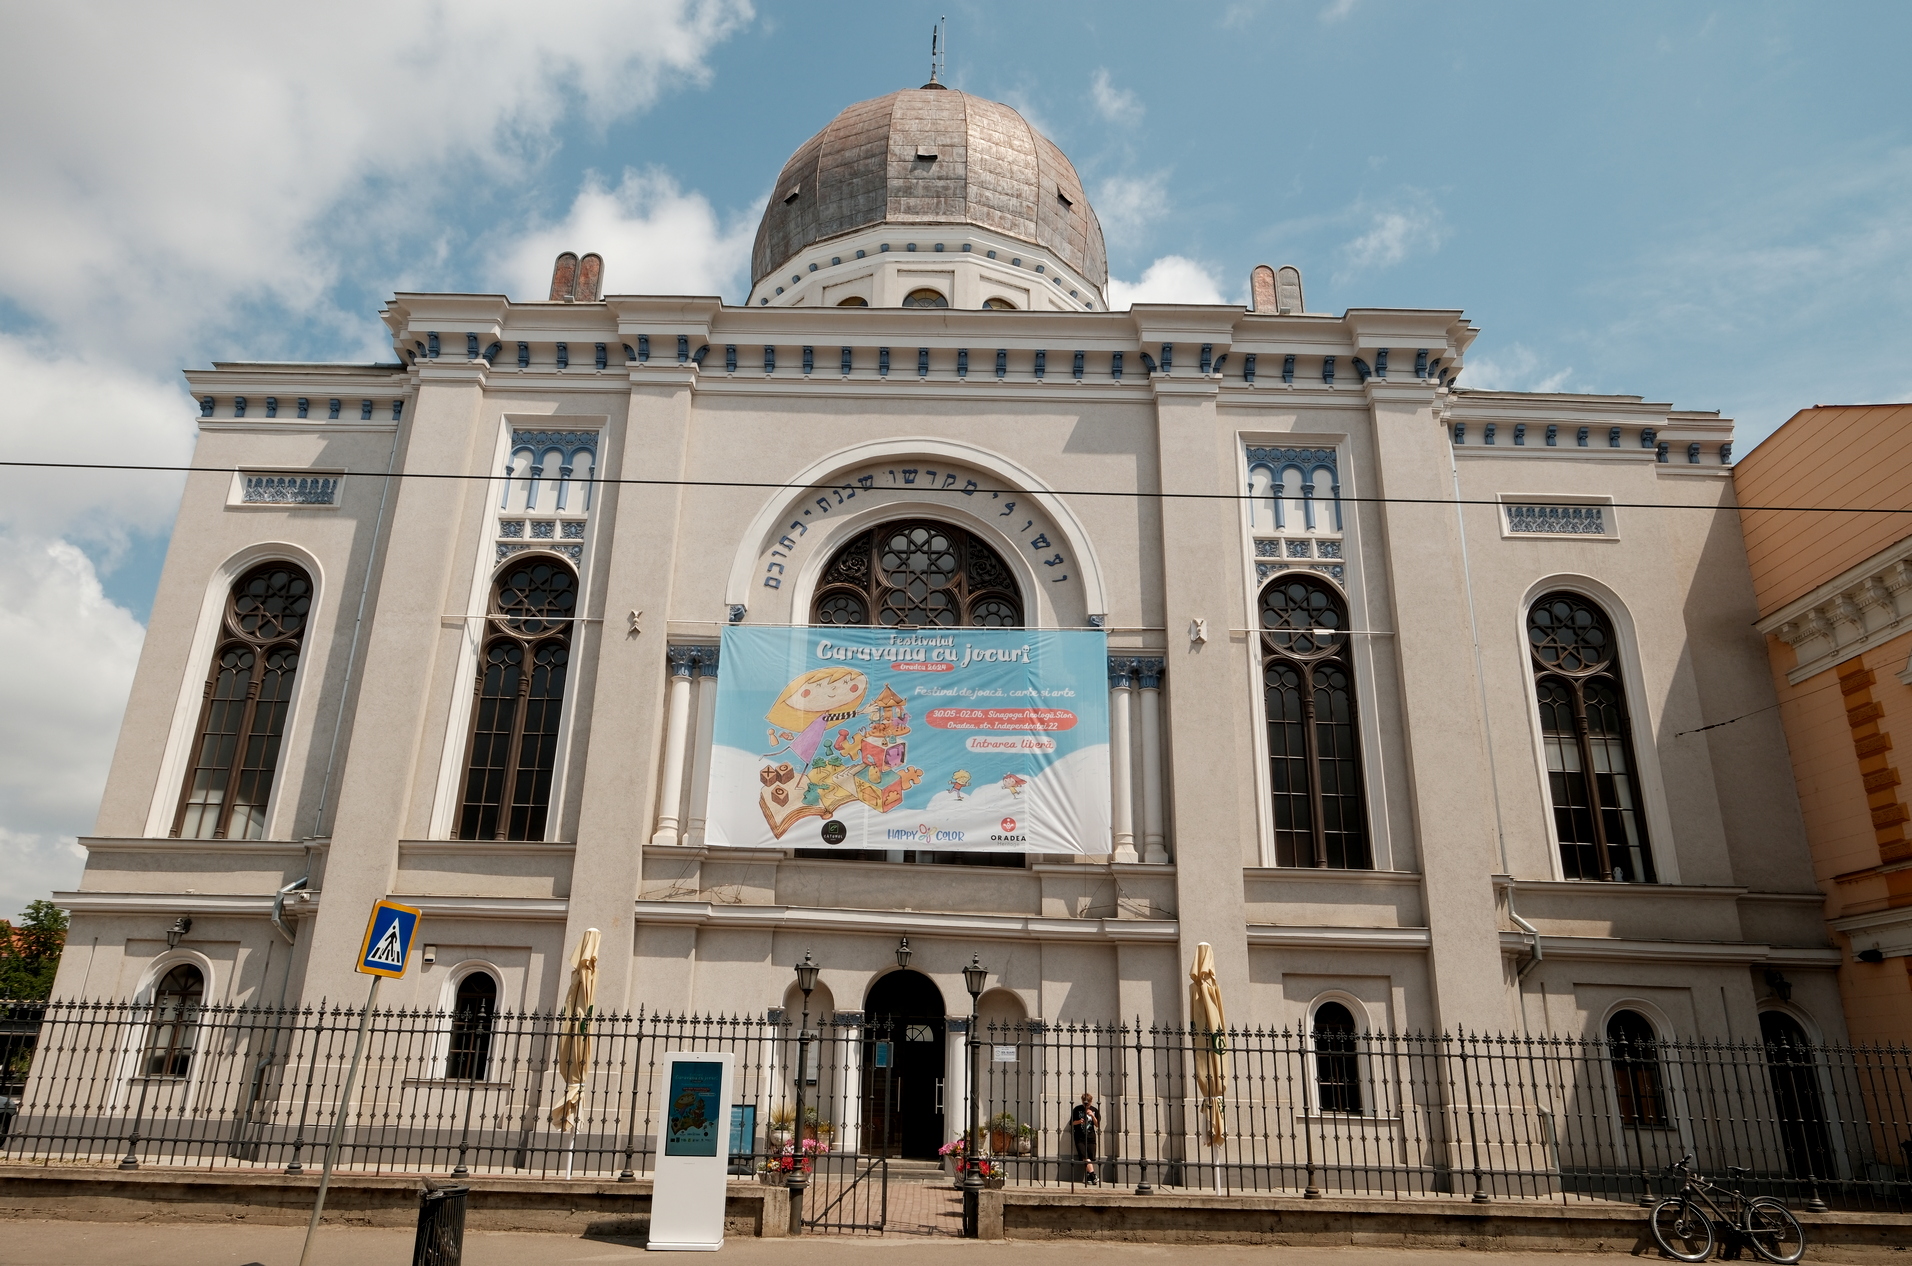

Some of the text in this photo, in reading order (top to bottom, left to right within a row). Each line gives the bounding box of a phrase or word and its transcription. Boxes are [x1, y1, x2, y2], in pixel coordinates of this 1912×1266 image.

[890, 635, 955, 647] Festivalul
[816, 640, 1031, 668] Caravana cu jocuri
[900, 663, 947, 671] Oradea 2024
[914, 686, 958, 697] Festival
[959, 687, 972, 696] de
[970, 687, 1007, 699] joacă,
[1009, 688, 1038, 697] carte
[1051, 687, 1076, 697] arte
[987, 711, 1023, 720] Sinagoga
[1055, 711, 1073, 719] Sion
[947, 722, 978, 730] Oradea,
[1048, 722, 1058, 730] 22
[971, 738, 1054, 749] Intrarea liberă
[887, 829, 965, 842] HAPPY COLOR
[990, 834, 1027, 842] ORADEA
